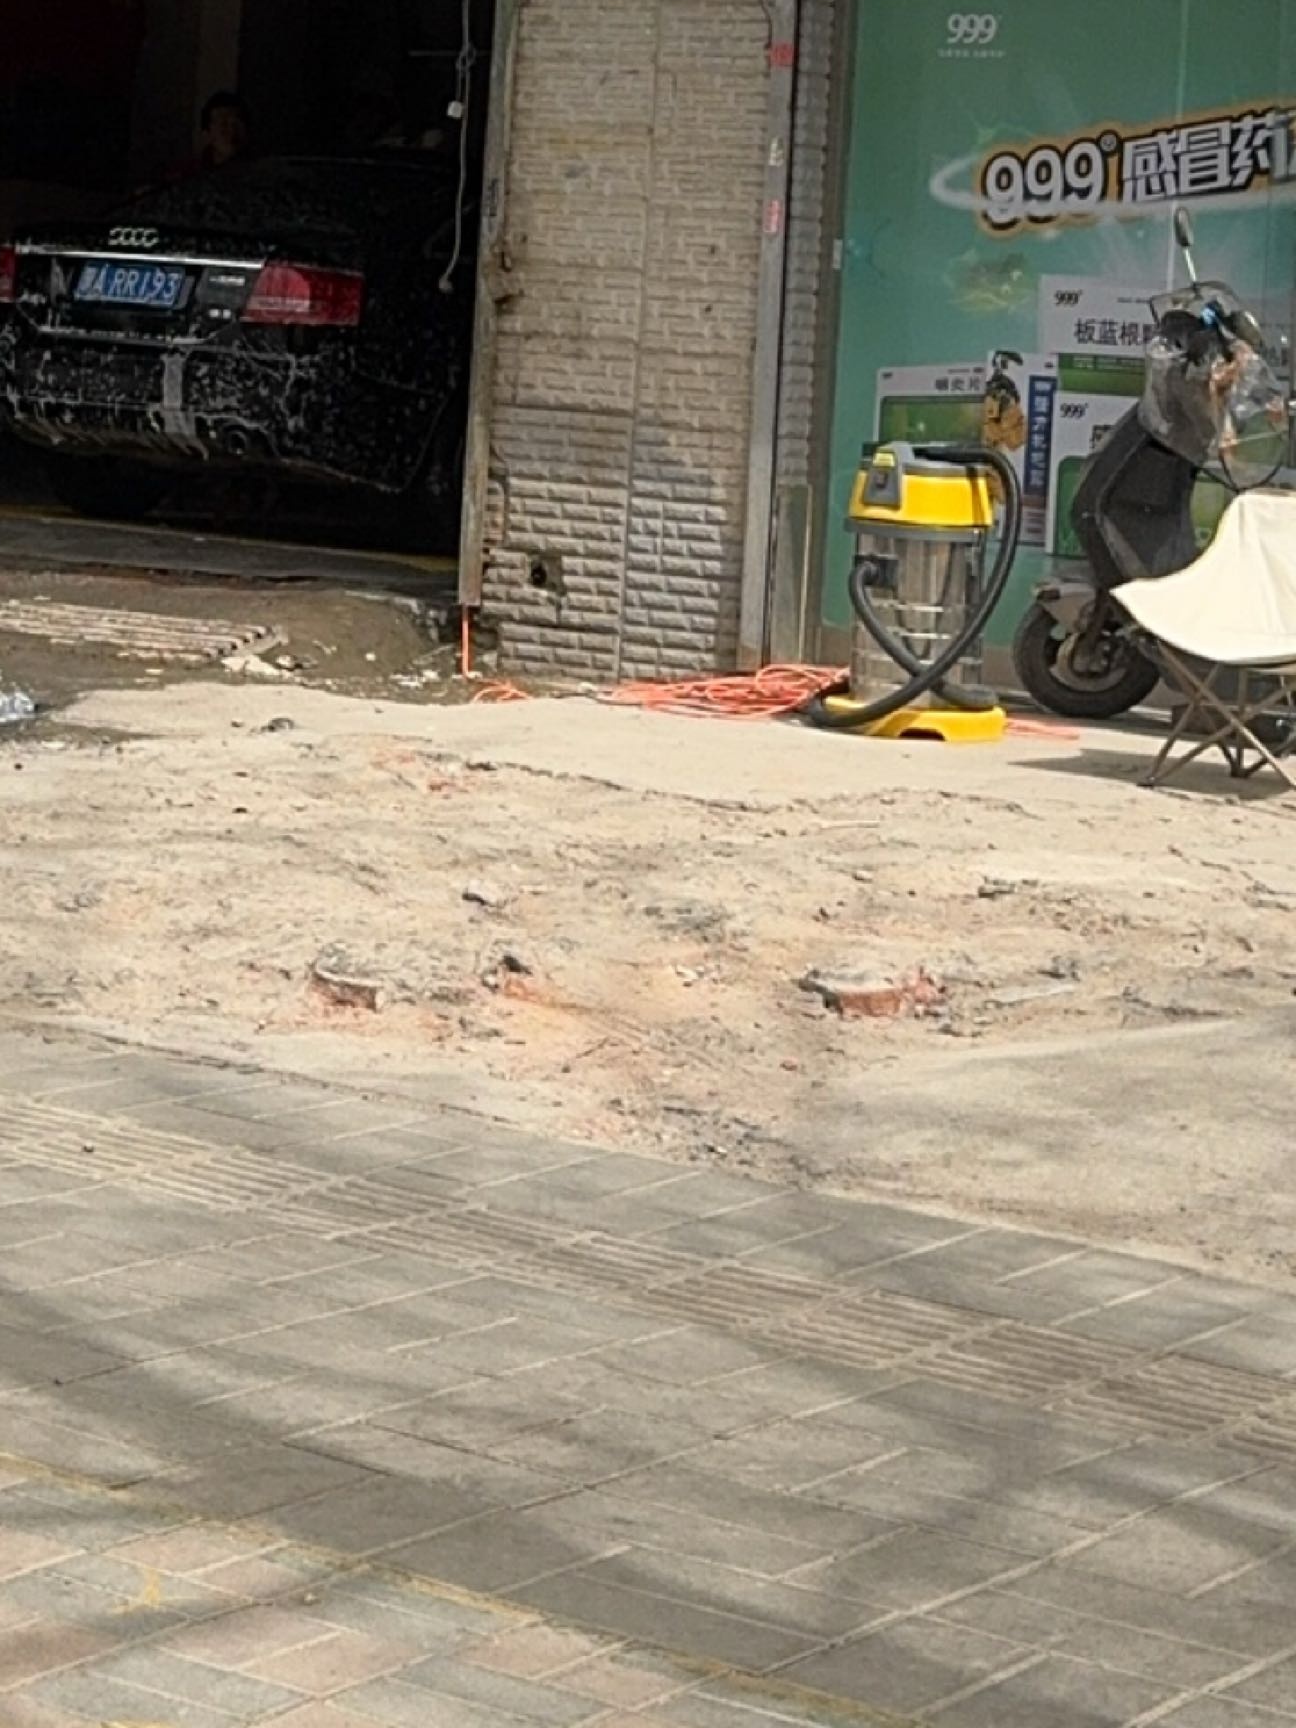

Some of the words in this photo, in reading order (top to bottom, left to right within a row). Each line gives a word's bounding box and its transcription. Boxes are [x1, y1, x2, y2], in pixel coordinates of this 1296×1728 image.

[946, 13, 997, 44] 999
[1121, 109, 1296, 205] 感冒药
